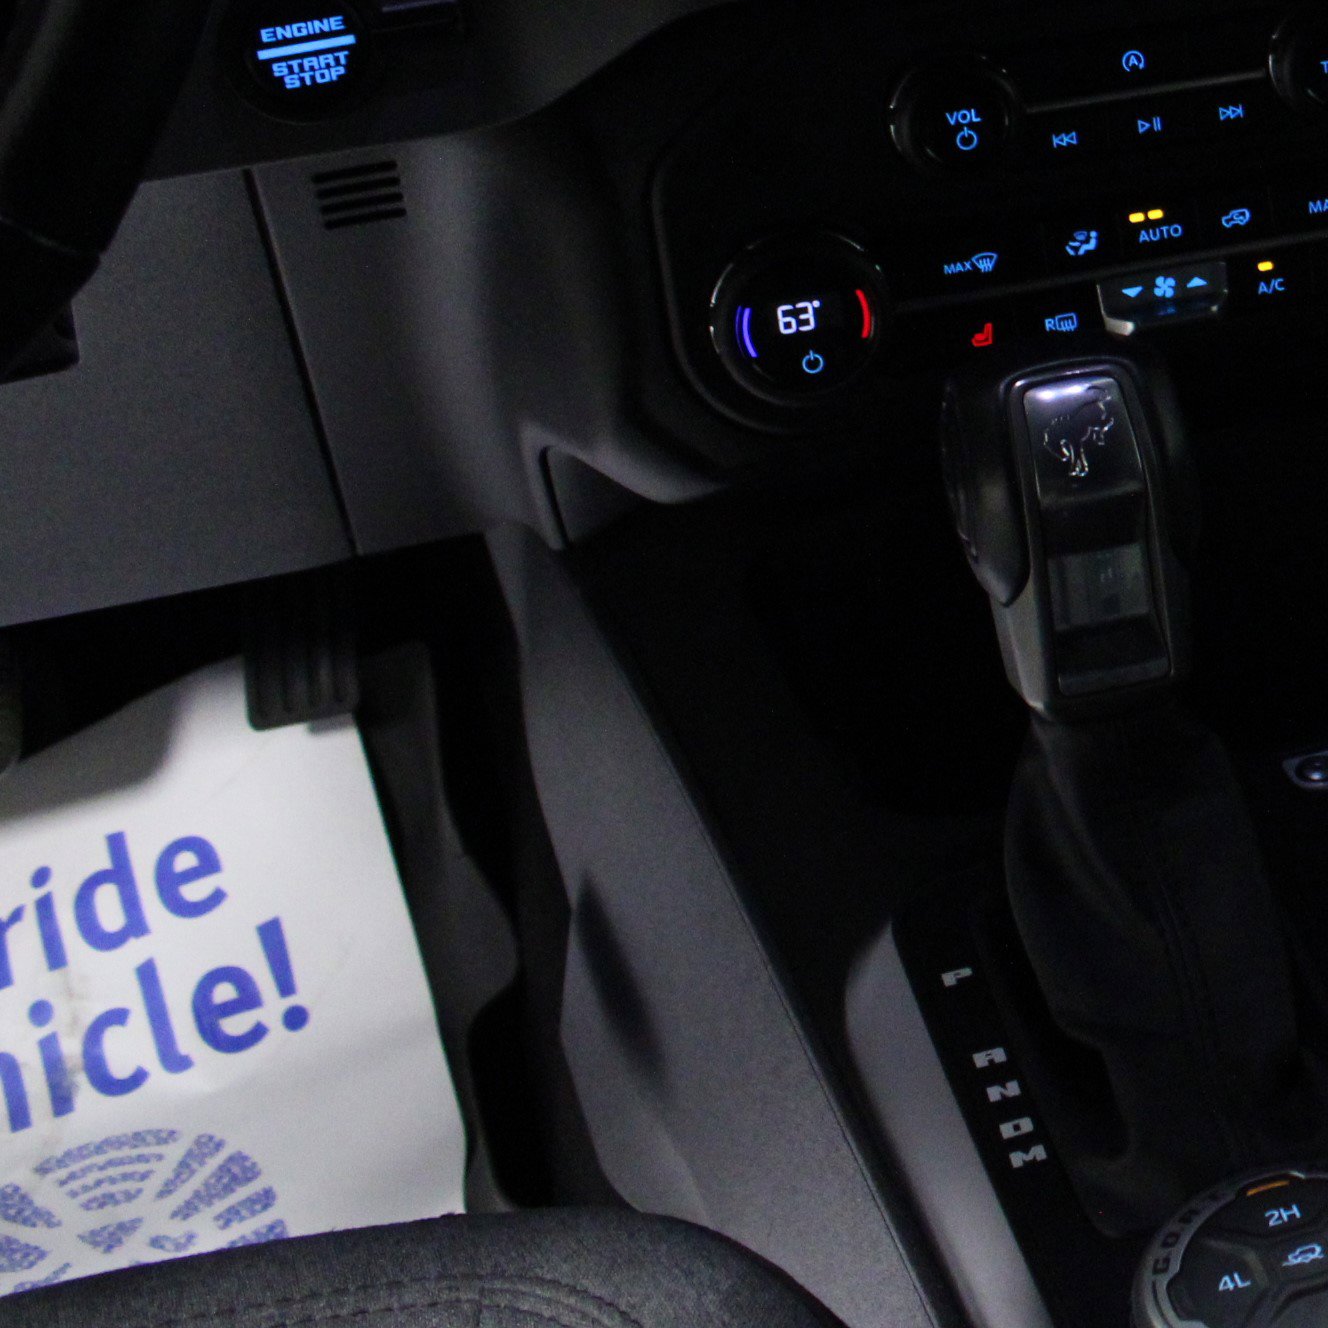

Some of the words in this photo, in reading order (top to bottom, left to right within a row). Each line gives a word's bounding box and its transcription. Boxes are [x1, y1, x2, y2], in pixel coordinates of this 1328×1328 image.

[260, 15, 347, 43] ENGINE
[271, 51, 349, 77] START
[283, 66, 346, 89] STOP
[945, 109, 982, 126] VOL
[1138, 224, 1183, 243] AUTO
[943, 260, 973, 275] MAX
[1258, 278, 1286, 294] A/C
[0, 832, 228, 989] ride
[941, 967, 973, 988] P
[986, 1079, 1021, 1103] N
[999, 1116, 1034, 1140] D
[1008, 1144, 1048, 1169] M
[1264, 1204, 1301, 1227] 2H
[1218, 1272, 1251, 1291] 4L
